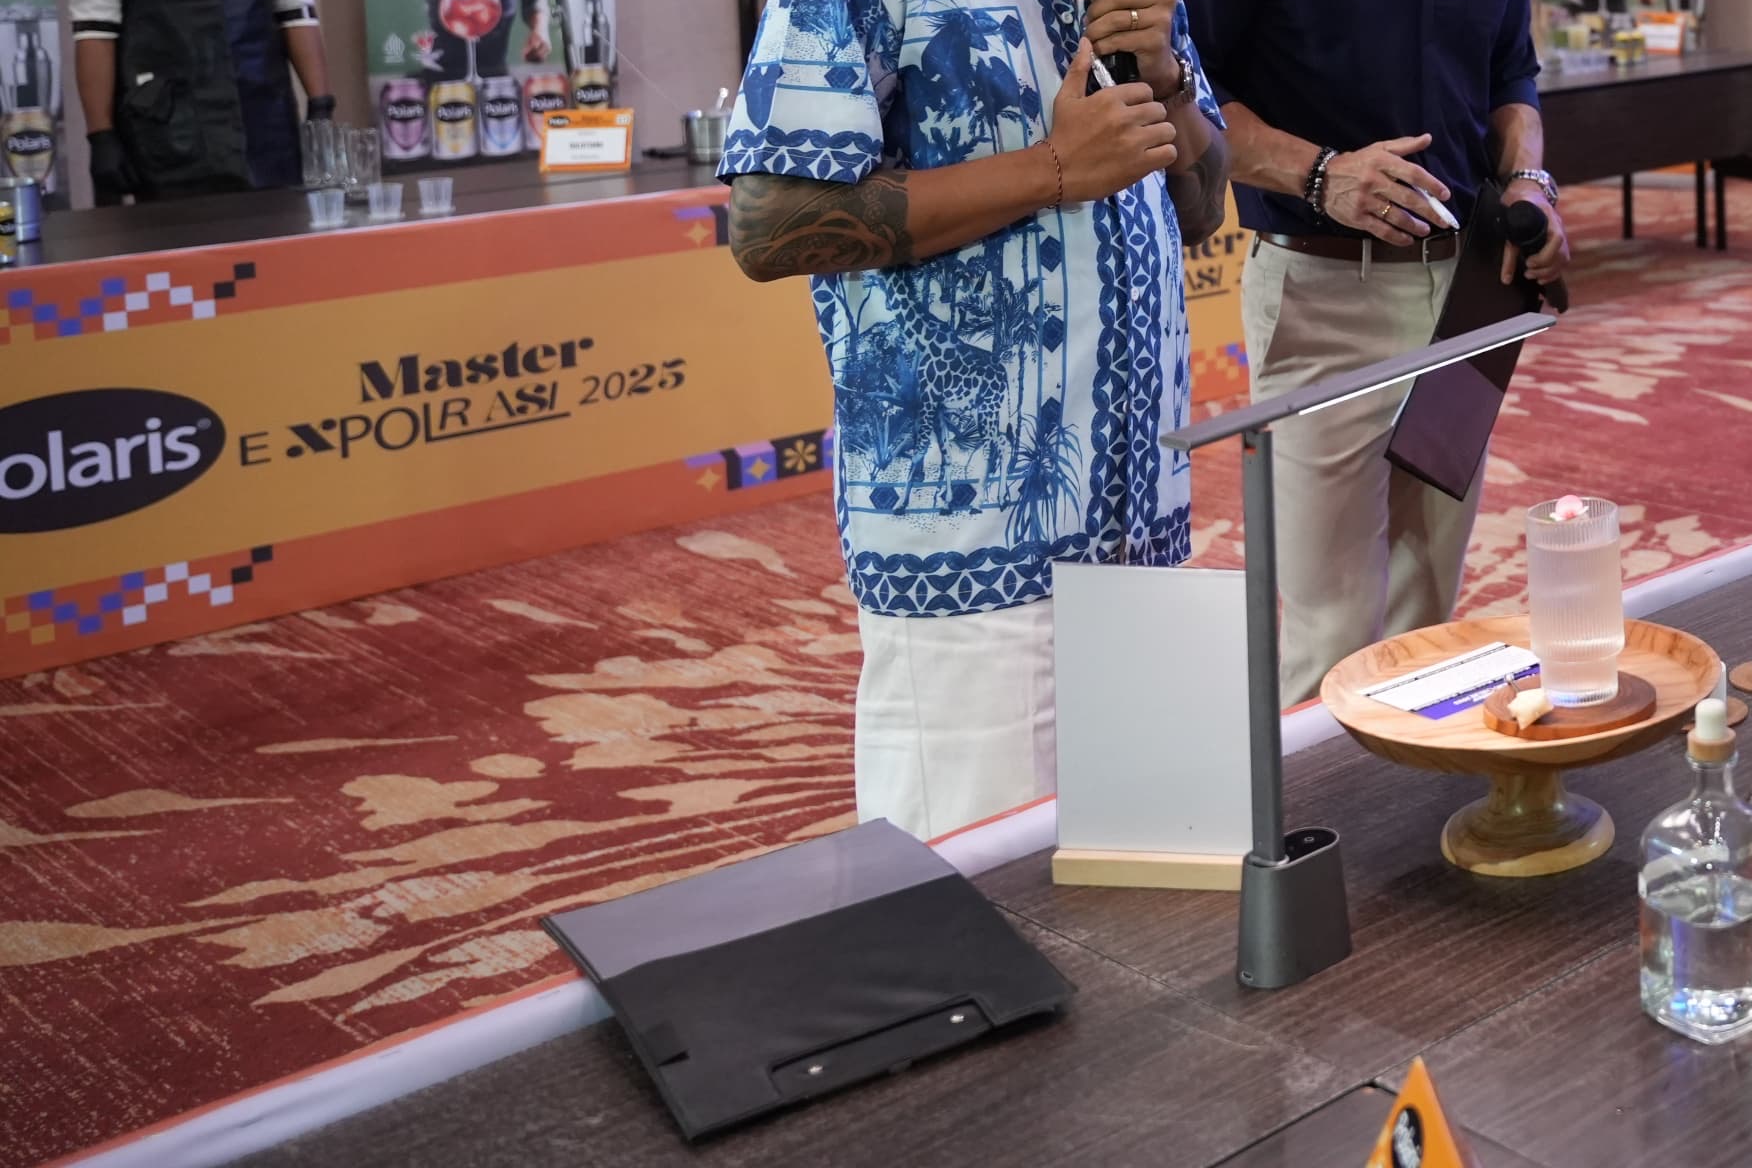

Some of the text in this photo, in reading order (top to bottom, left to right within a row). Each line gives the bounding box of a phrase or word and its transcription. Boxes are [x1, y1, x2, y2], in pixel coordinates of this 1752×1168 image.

[360, 336, 594, 403] Master
[579, 357, 687, 405] 2025
[0, 417, 201, 499] olaris
